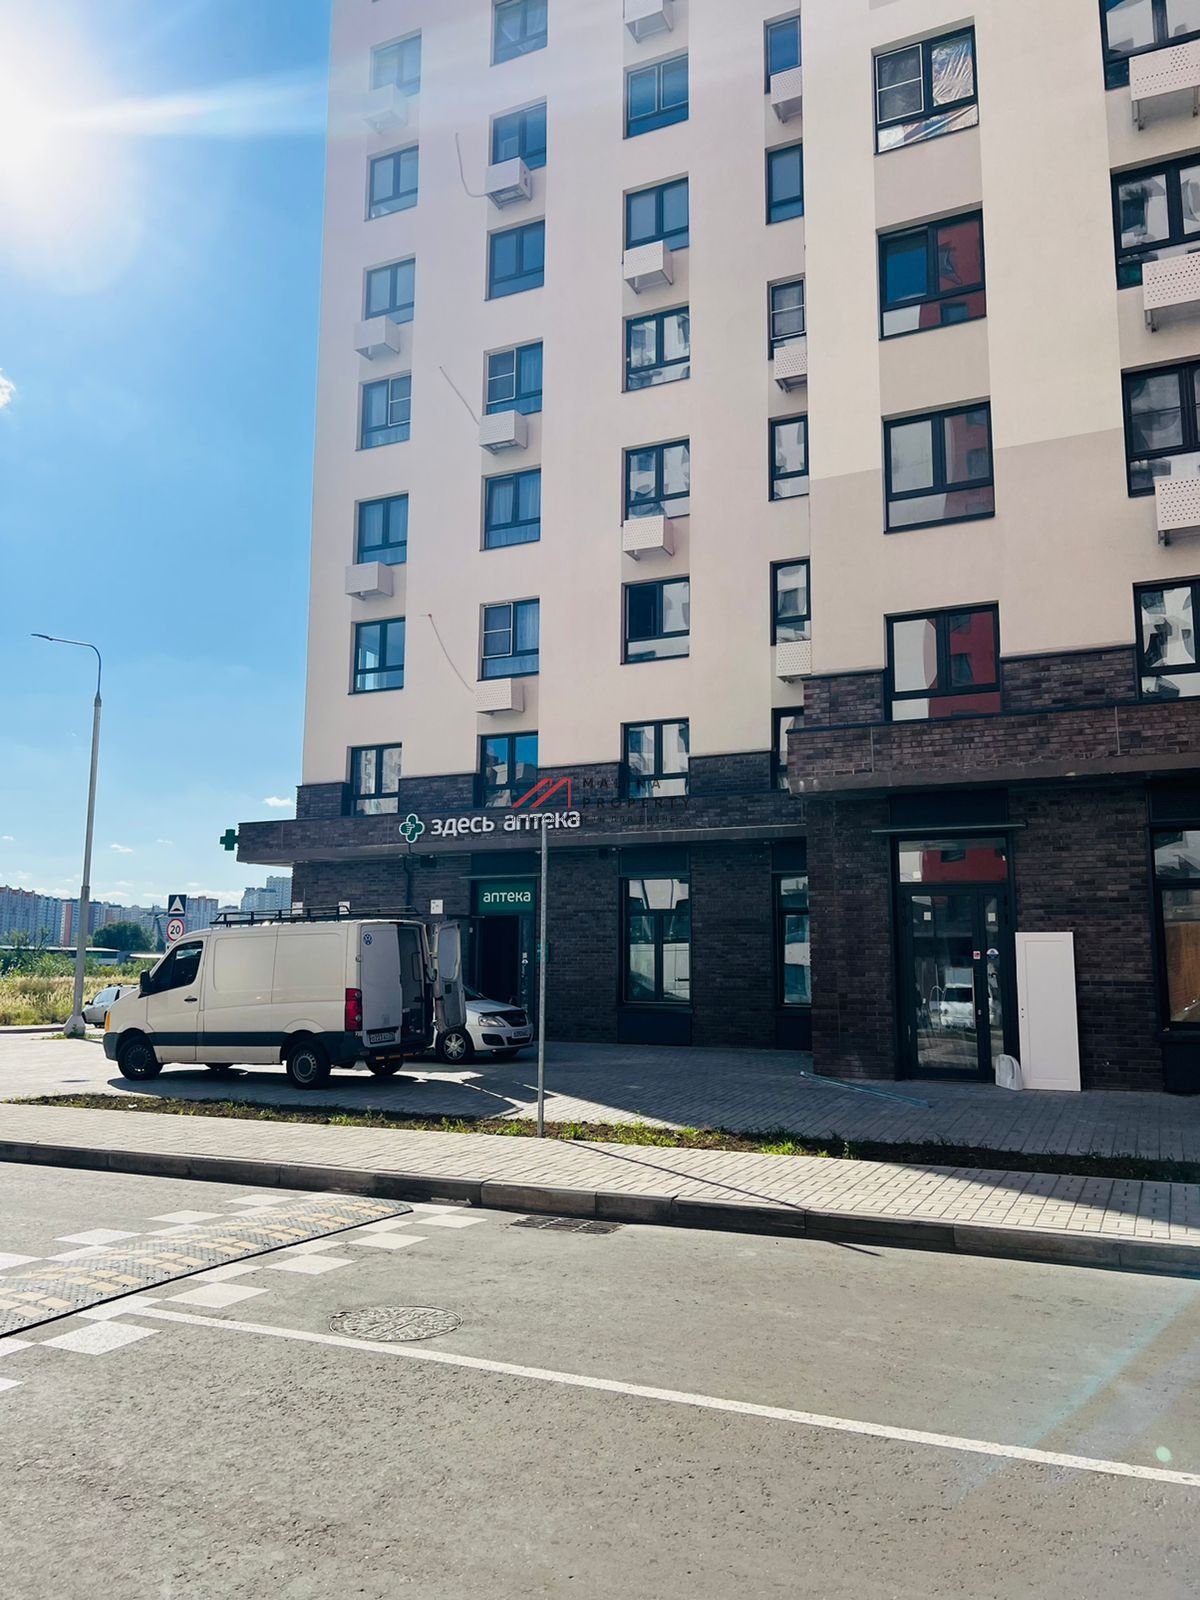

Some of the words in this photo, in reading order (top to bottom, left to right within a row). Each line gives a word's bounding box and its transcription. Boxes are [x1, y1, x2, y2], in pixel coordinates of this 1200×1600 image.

[431, 816, 495, 837] здесь
[503, 811, 581, 832] аптека
[483, 891, 531, 903] аптека
[170, 925, 181, 935] 20
